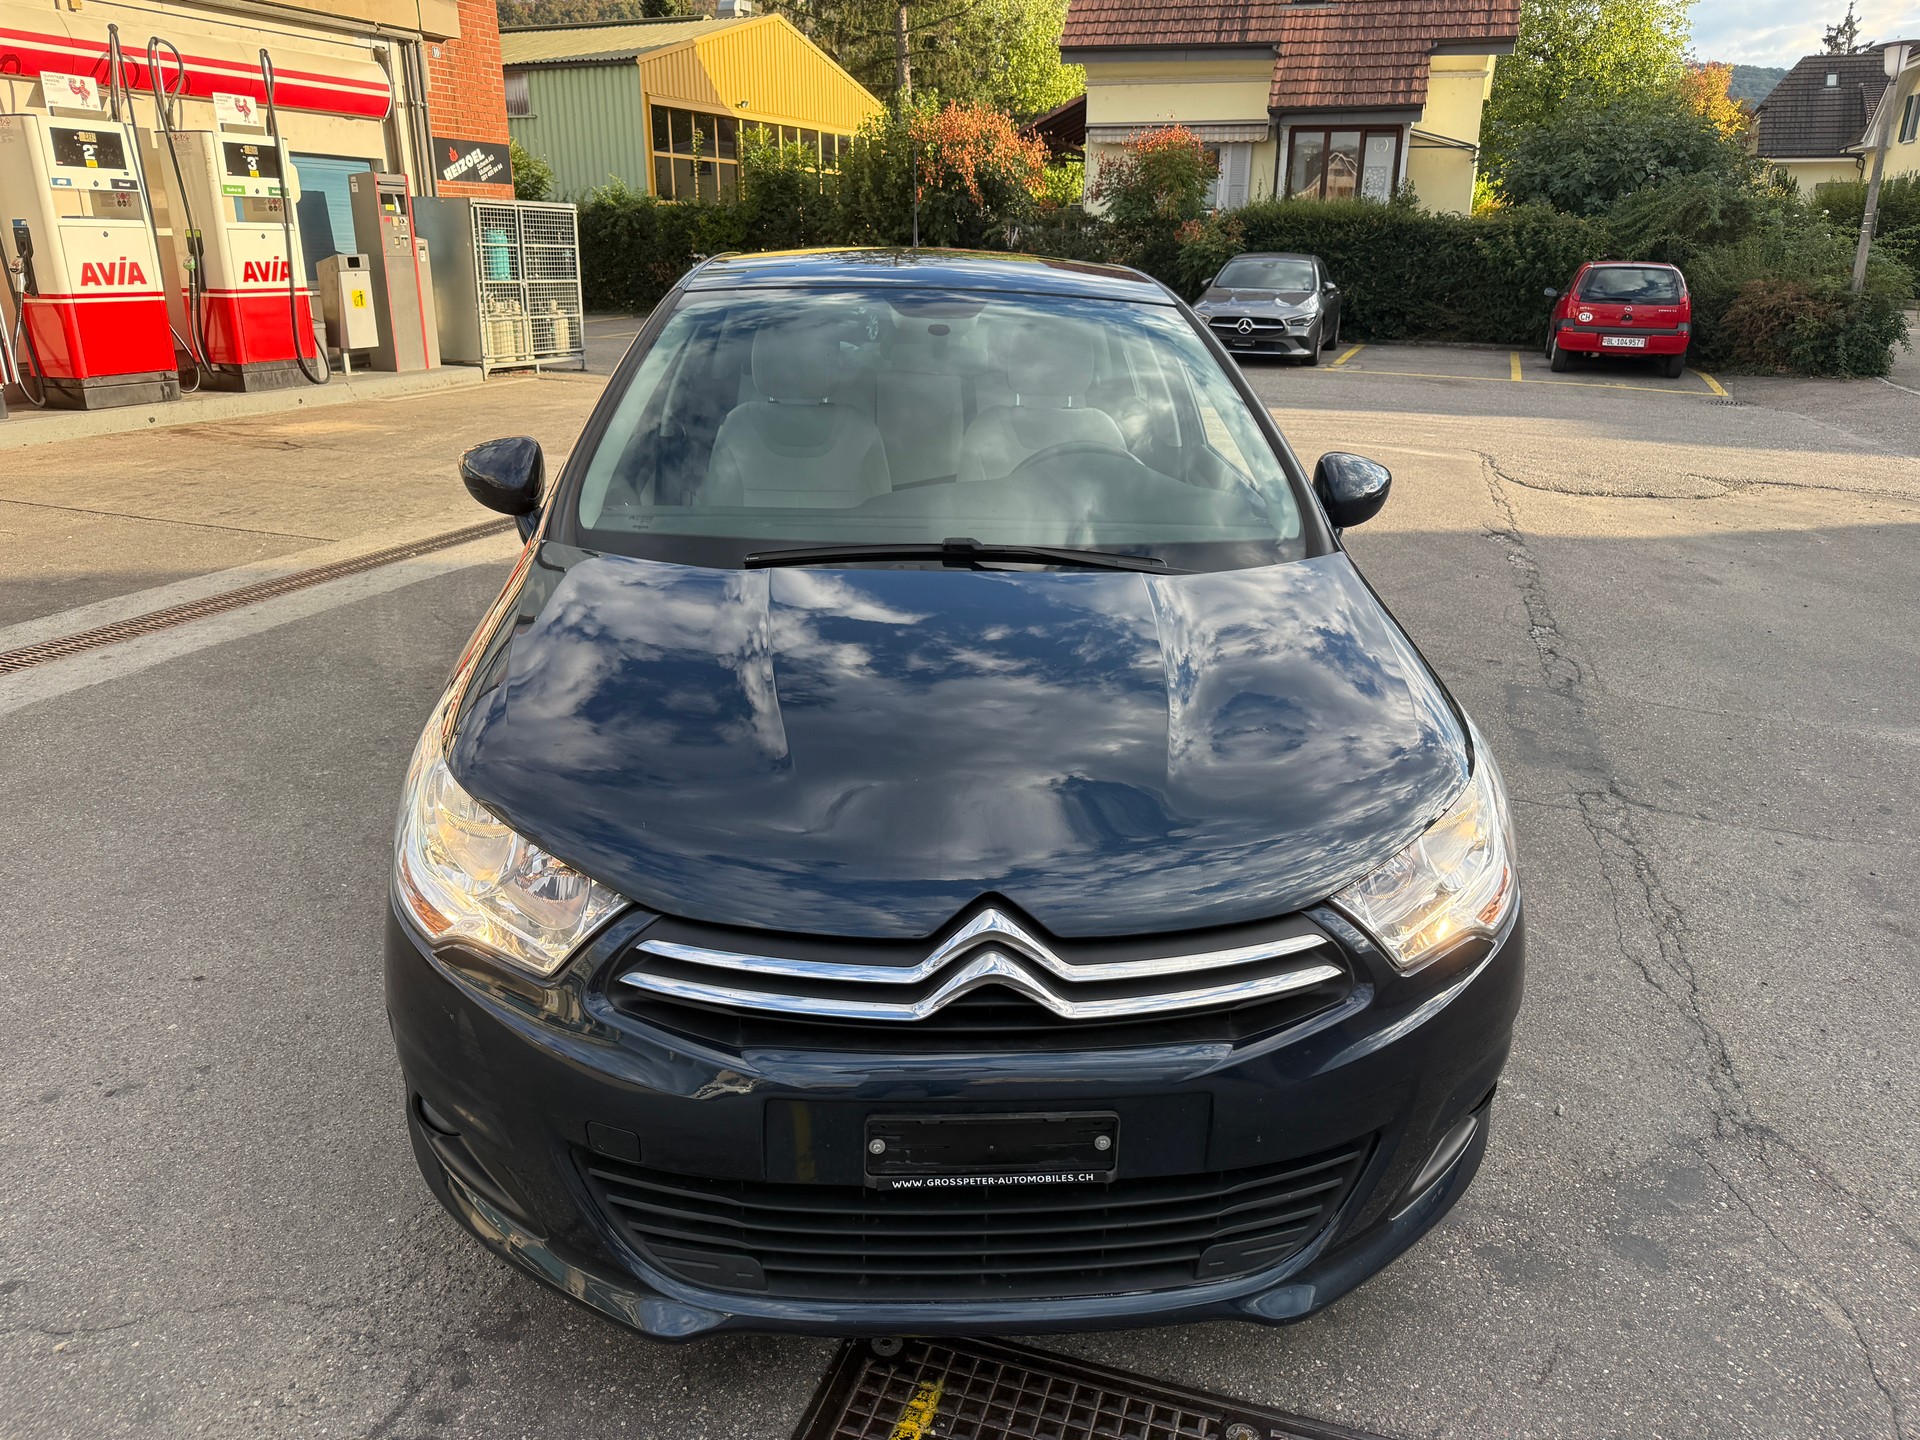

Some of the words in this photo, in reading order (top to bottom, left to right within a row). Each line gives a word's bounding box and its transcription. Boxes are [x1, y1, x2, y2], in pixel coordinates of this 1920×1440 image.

[82, 144, 96, 160] 2
[246, 156, 258, 171] 3
[443, 148, 485, 181] HEIZOEL
[1580, 313, 1591, 321] CH
[891, 1173, 1094, 1189] WWW.GROSSPETER-AUTOMOBILES.CH
